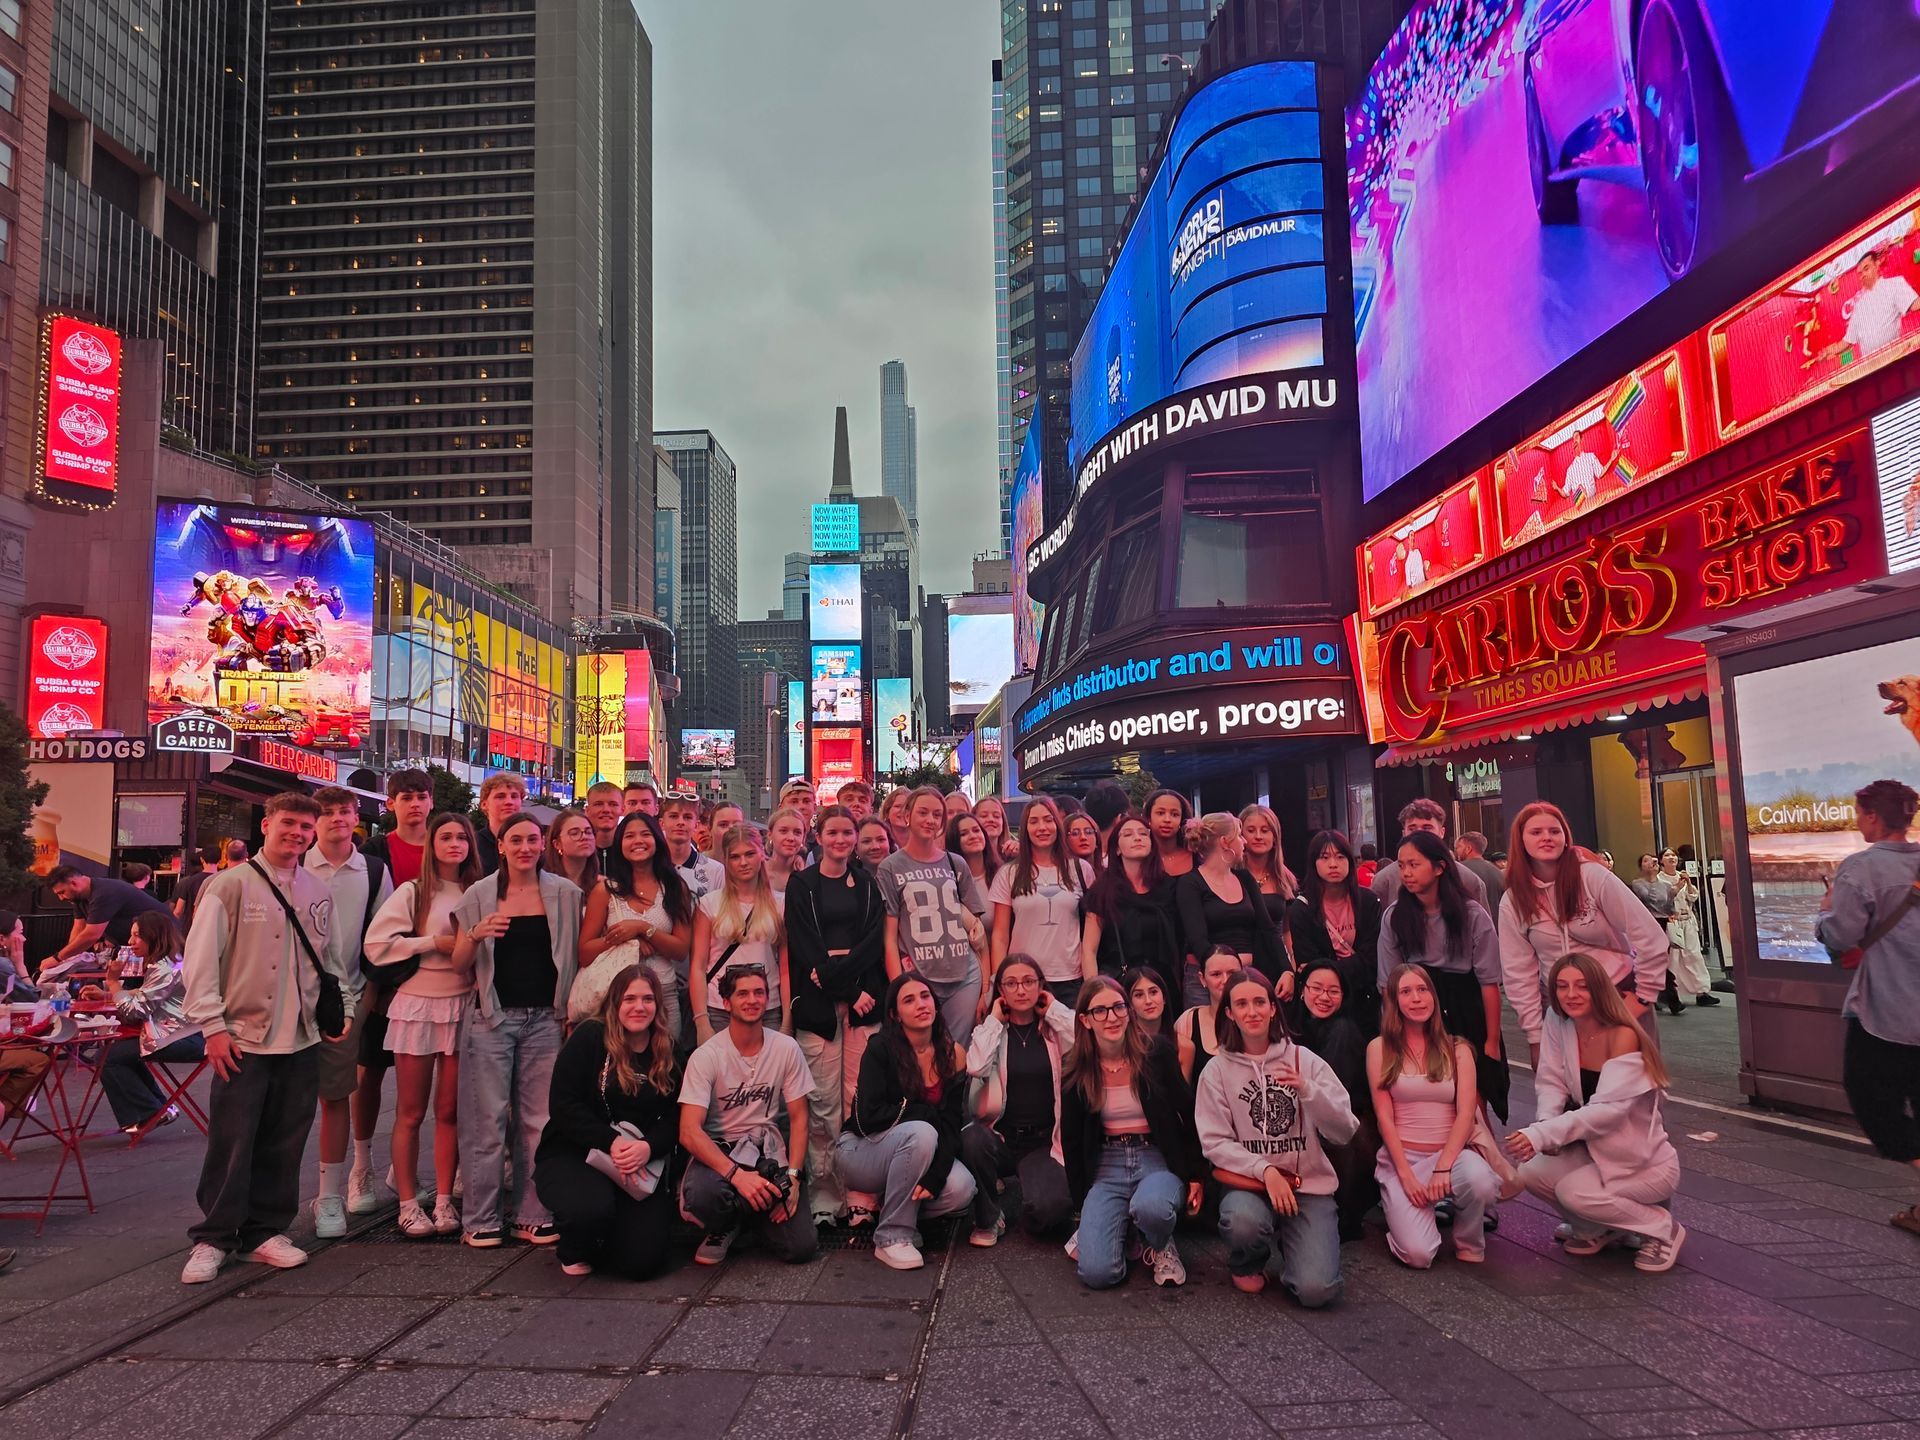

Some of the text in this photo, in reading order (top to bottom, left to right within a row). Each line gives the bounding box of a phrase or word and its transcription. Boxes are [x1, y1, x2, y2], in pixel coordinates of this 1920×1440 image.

[1226, 219, 1296, 248] DAVID MUIR
[56, 375, 115, 395] BUBBA GUMP
[59, 383, 111, 402] SHRIMP CO.
[52, 449, 112, 467] BUBBA GUMP
[55, 457, 108, 475] SHRIMP CO.
[1040, 519, 1067, 562] WORLD
[1110, 413, 1159, 465] WITH
[1166, 384, 1266, 436] DAVID
[1698, 449, 1842, 548] BAKE
[230, 517, 266, 526] WITNESS
[814, 515, 856, 523] NOW WHAT?
[814, 532, 856, 540] NOW WHAT?
[656, 521, 669, 594] TIMES
[1700, 516, 1848, 608] SHOP
[1745, 629, 1777, 645] NS4031
[515, 650, 536, 675] THE
[36, 677, 100, 687] BUBBA GUMP
[1052, 682, 1071, 711] finds
[1073, 658, 1161, 700] distributor
[1169, 642, 1232, 677] and
[1242, 637, 1302, 669] will
[1313, 643, 1339, 671] o
[1473, 650, 1618, 710] TIMES SQUARE
[39, 685, 96, 695] SHRIMP CO.
[178, 720, 216, 735] BEER
[228, 723, 286, 731] EPTEMBER
[1046, 733, 1065, 758] miss
[1066, 719, 1105, 752] Chiefs
[1109, 708, 1208, 745] opener,
[29, 740, 146, 759] HOTDOGS
[165, 734, 226, 749] GARDEN
[264, 740, 337, 782] BEER GARDEN
[1759, 801, 1857, 826] Calvin Klein
[895, 868, 962, 886] BROOKL
[914, 942, 970, 961] NEW YOR
[1238, 1074, 1299, 1104] BARELN
[1243, 1136, 1307, 1155] UNIVERSITY
